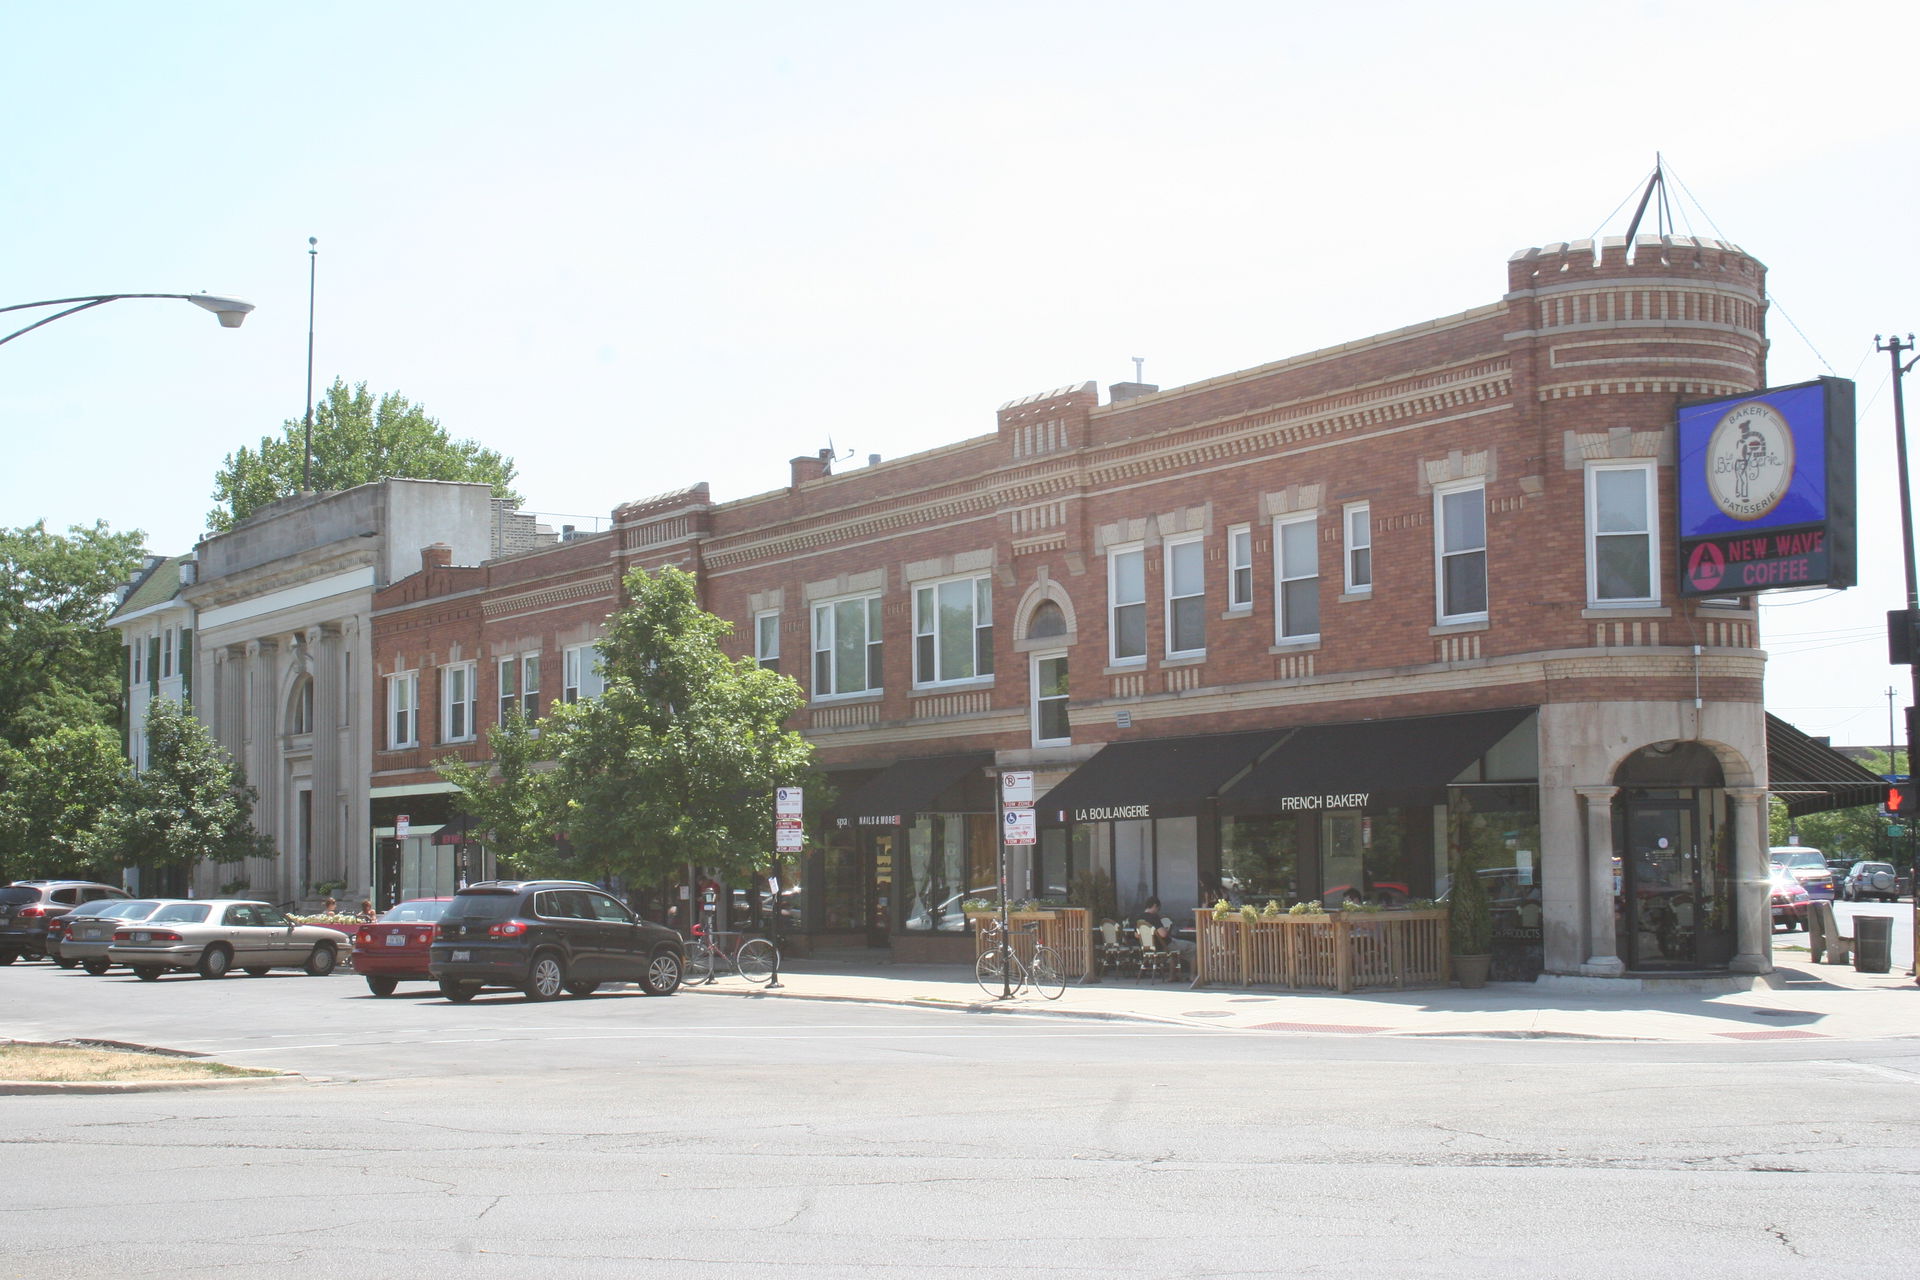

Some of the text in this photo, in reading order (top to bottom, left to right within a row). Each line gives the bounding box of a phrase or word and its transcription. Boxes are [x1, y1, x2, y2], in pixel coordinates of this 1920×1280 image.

[1729, 406, 1769, 424] BAKERY
[1723, 491, 1777, 514] PATISSERIE
[1728, 531, 1825, 562] NEW WAVE
[1743, 558, 1809, 585] COFFEE
[1281, 793, 1369, 810] FRENCH BAKERY
[859, 815, 875, 825] NAILS
[880, 815, 896, 825] MORE
[1075, 804, 1150, 821] LA BOULANGERIE
[836, 817, 848, 829] spa
[1503, 928, 1542, 938] PRODUCTS
